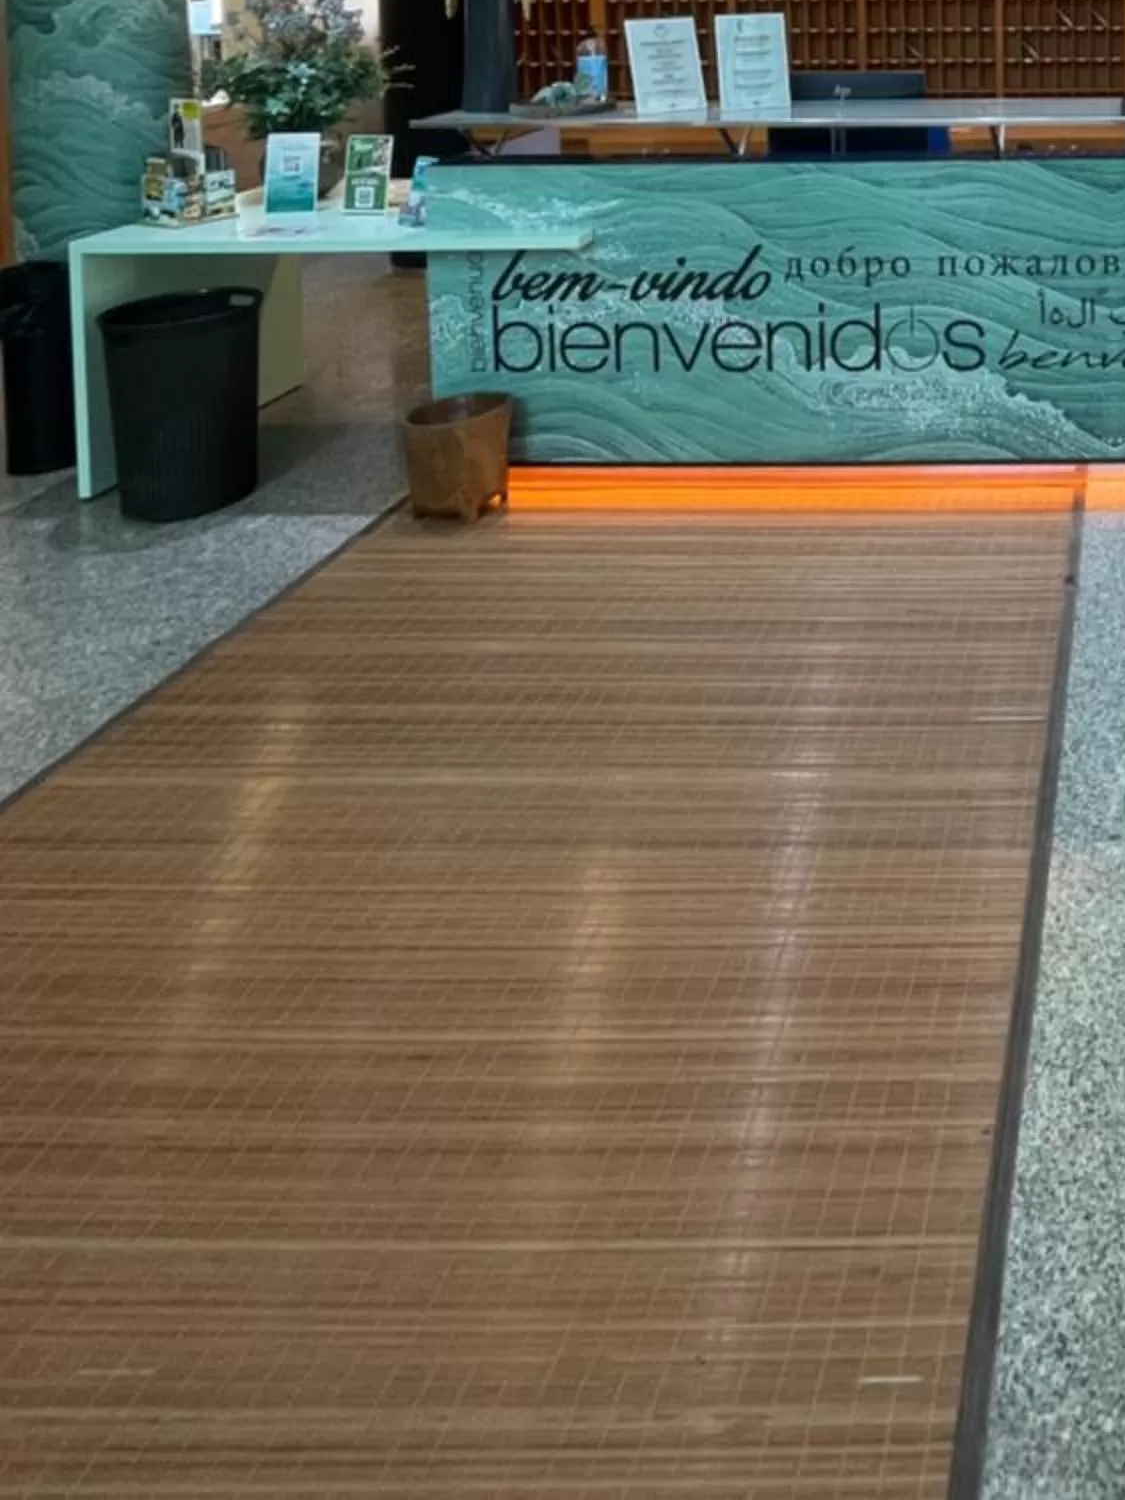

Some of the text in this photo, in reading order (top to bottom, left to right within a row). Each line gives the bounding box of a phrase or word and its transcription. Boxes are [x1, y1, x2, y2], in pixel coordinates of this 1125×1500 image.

[491, 245, 772, 302] bem-vindo
[784, 245, 911, 287] добро
[491, 303, 987, 373] bienvenidos
